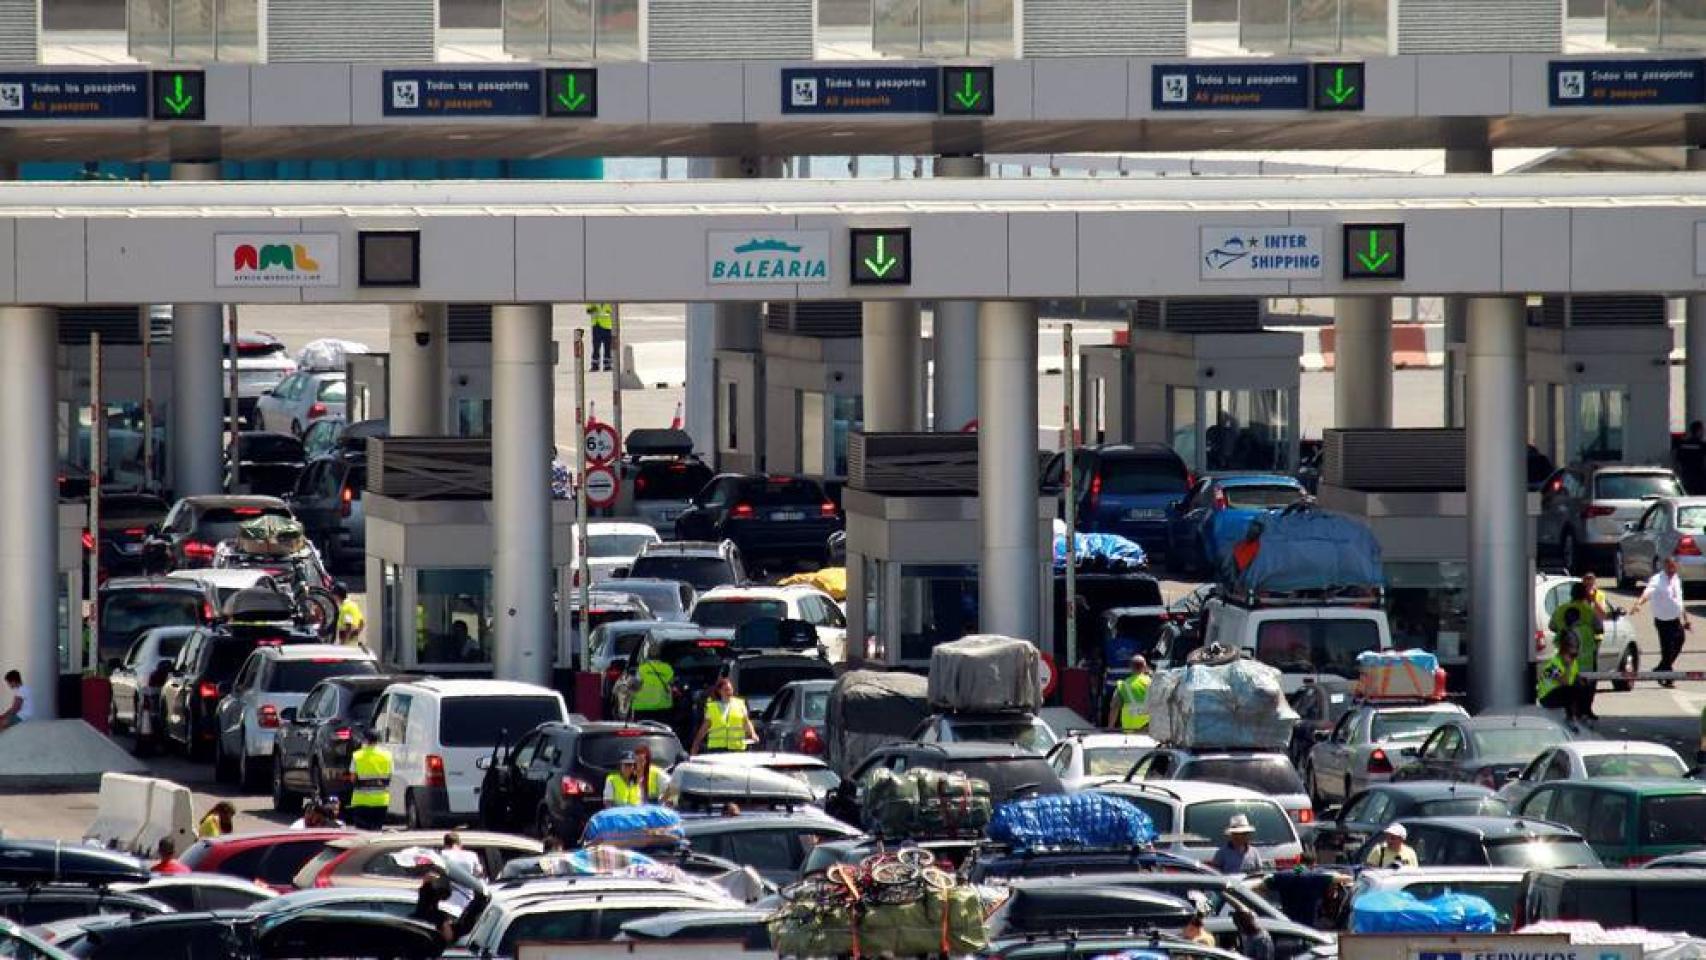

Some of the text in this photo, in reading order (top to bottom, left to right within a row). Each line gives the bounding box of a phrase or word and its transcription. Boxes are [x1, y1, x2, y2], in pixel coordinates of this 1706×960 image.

[1195, 75, 1298, 85] Todos los pasaportes
[1592, 70, 1694, 81] Todos los pasaportes
[31, 83, 136, 94] Todos los pasaportes
[427, 81, 530, 91] Todos los pasaportes
[825, 78, 926, 89] Todos los pasaportes
[1265, 235, 1307, 248] INTER
[234, 244, 319, 271] AML
[1251, 255, 1320, 269] SHIPPING
